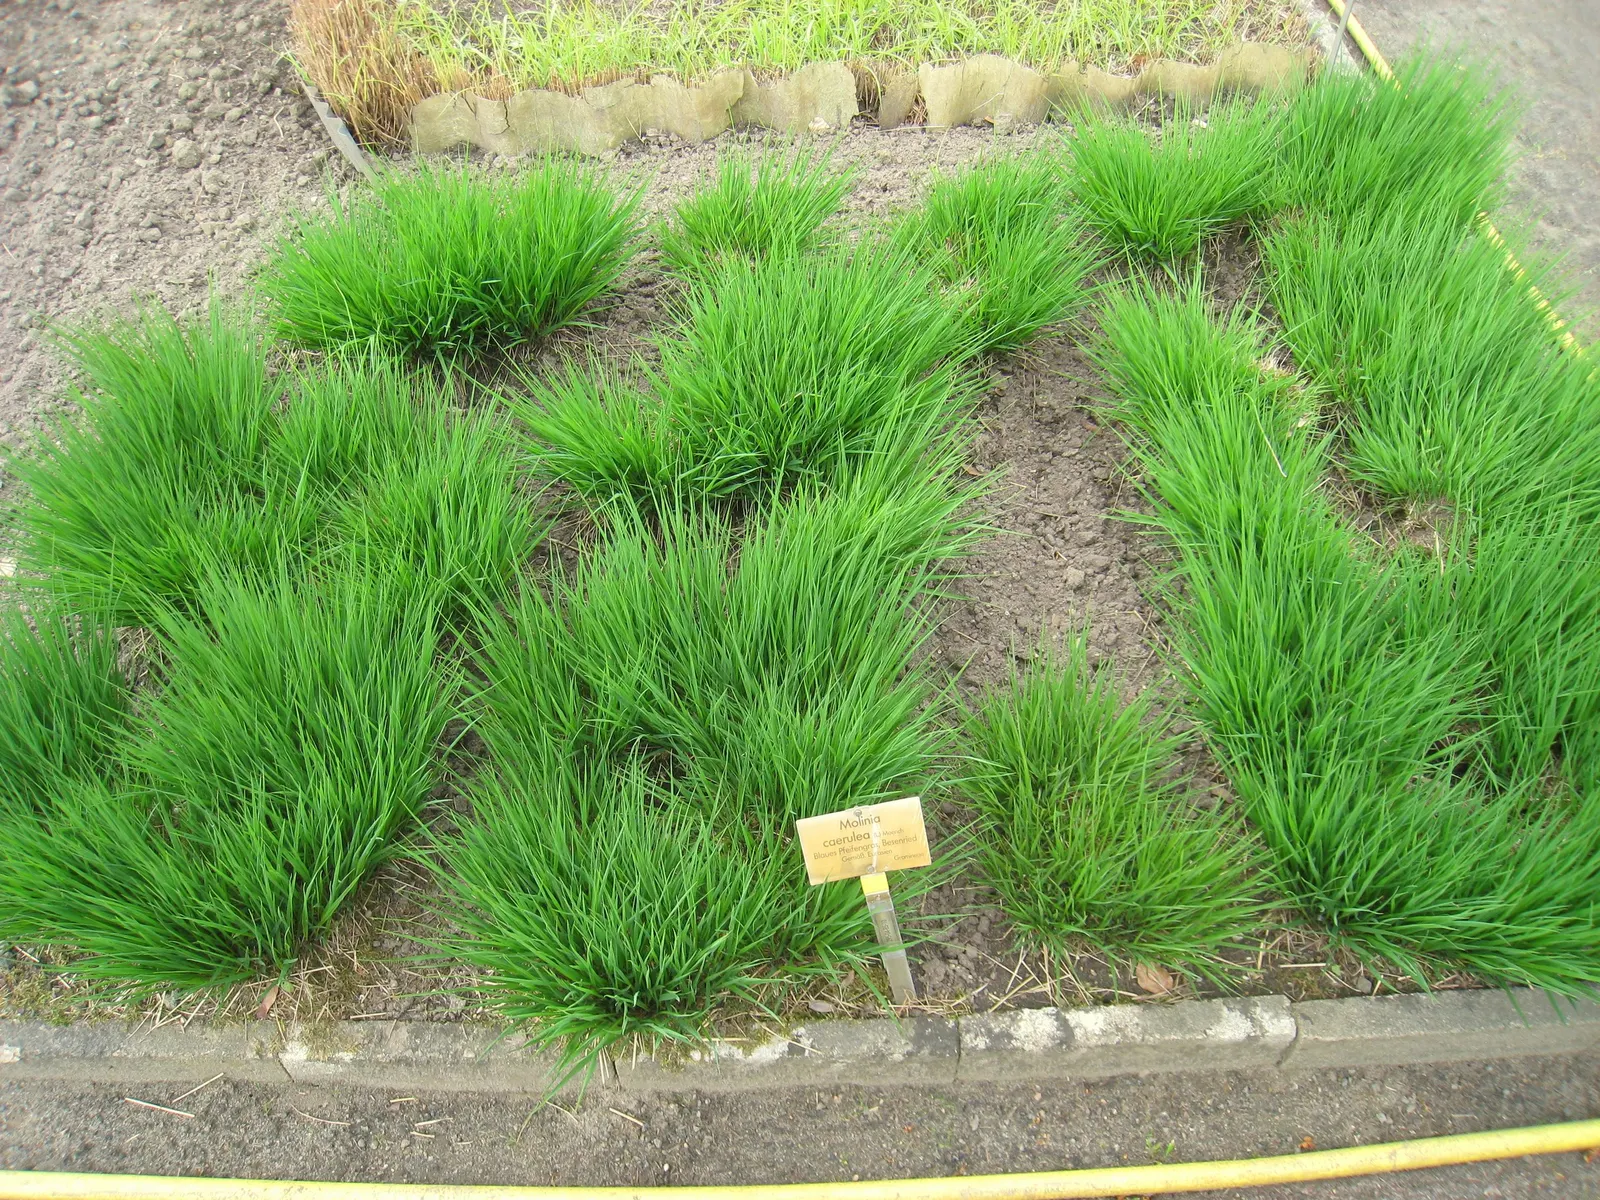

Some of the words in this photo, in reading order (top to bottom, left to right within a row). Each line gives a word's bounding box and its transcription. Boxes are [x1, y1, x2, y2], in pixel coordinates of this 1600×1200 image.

[840, 814, 881, 831] Molinia
[813, 850, 837, 860] Blaues
[882, 833, 918, 847] Besenried
[823, 831, 870, 848] caerulea
[867, 849, 893, 858] Euasien
